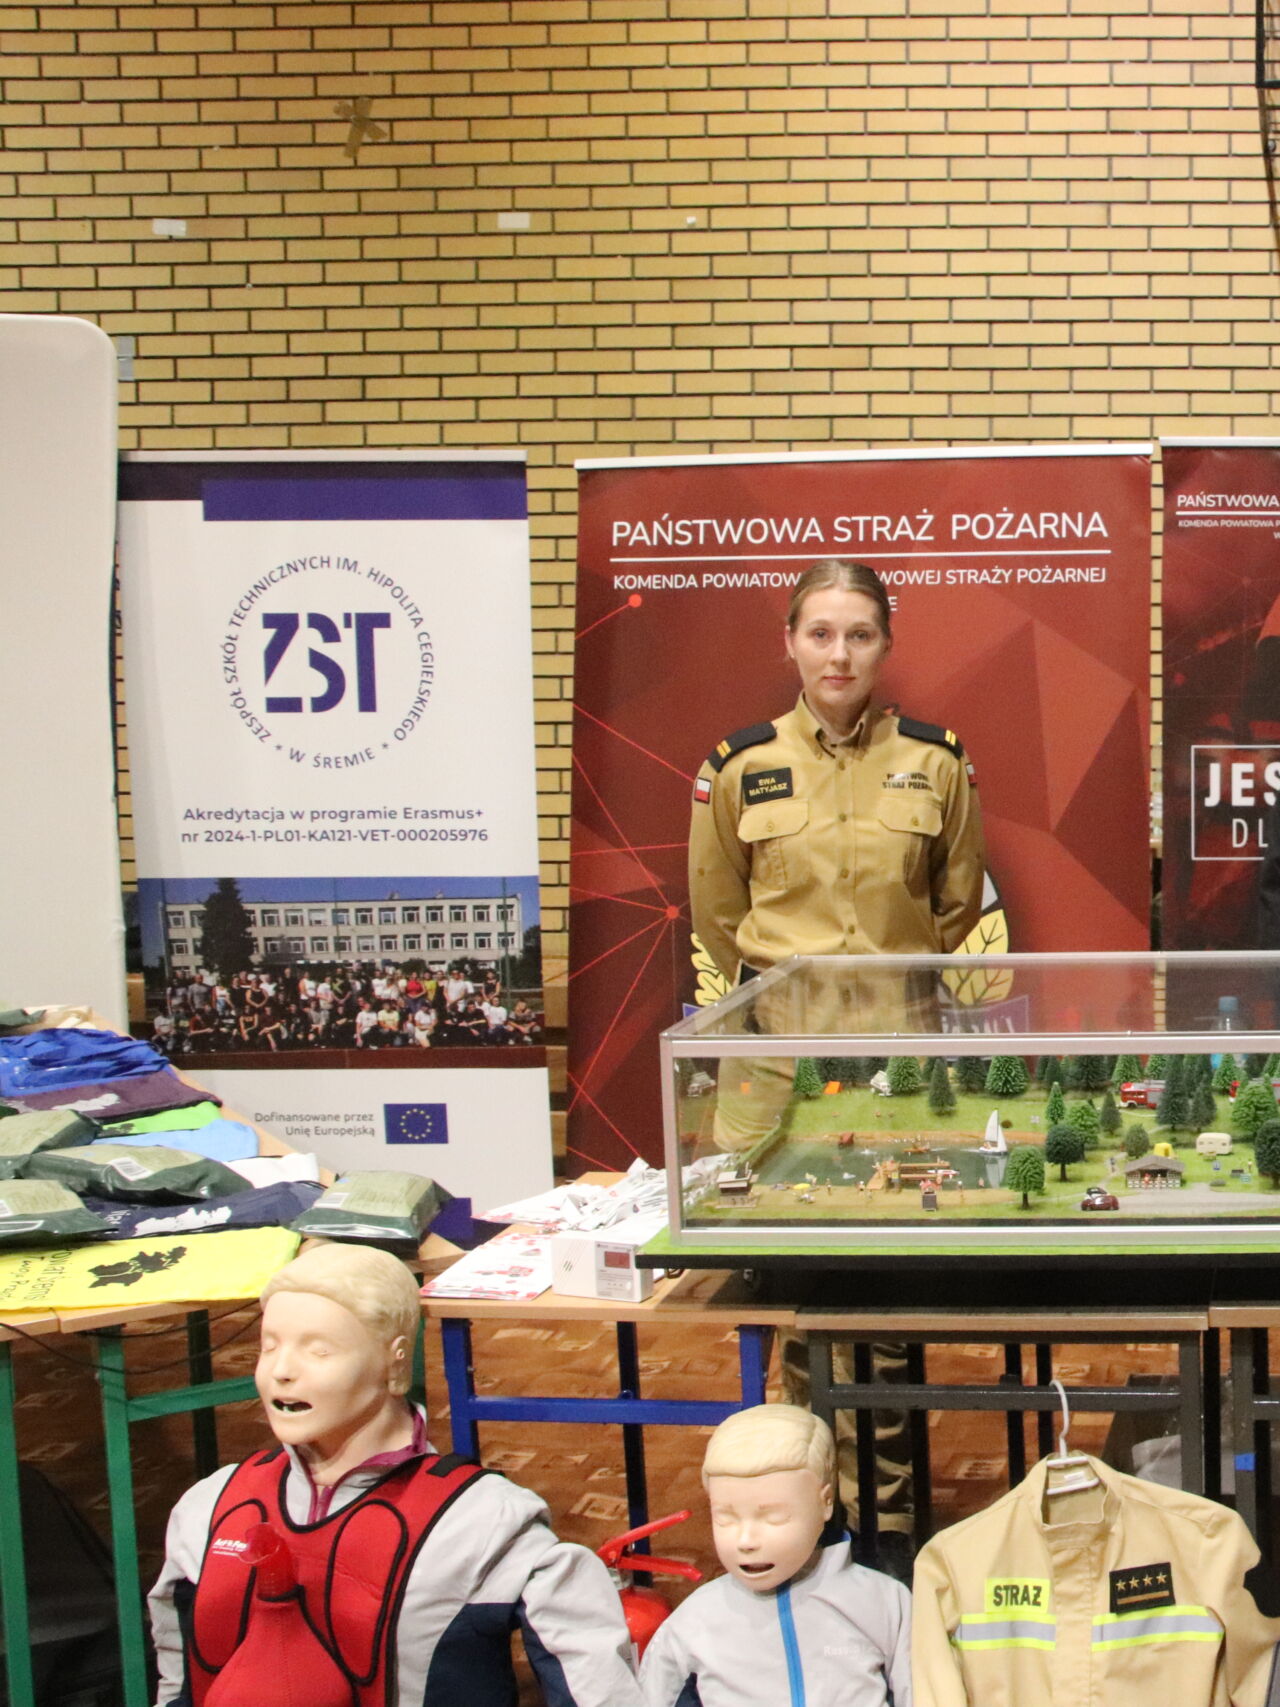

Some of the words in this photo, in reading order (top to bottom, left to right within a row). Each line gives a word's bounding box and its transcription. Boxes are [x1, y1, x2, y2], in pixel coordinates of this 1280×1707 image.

[1177, 491, 1280, 508] PAŃSTWOWA
[612, 513, 825, 546] PAŃSTWOWA
[833, 508, 934, 543] STRAŻ
[952, 507, 1109, 540] POŻARNA
[1178, 519, 1219, 528] KOMENDA
[1220, 519, 1274, 528] POWIATOWA
[336, 557, 362, 576] IM.
[613, 574, 699, 590] KOMENDA
[702, 572, 801, 588] POWIATOW
[875, 569, 941, 585] WOWEJ
[946, 565, 1012, 585] STRAŻY
[1017, 565, 1106, 584] POŻARNEJ
[228, 556, 331, 628] TECHNICZNYCH
[367, 567, 424, 629] HIPOLITA
[220, 633, 239, 685] SZKÓŁ
[262, 612, 391, 713] ZST
[393, 631, 435, 742] CEGIELSKIEGO
[229, 687, 272, 743] ZESPÓŁ
[312, 747, 376, 769] ŚREMIE
[183, 808, 285, 823] Akredytacja
[291, 811, 305, 820] w
[310, 807, 398, 823] programie
[403, 807, 484, 820] Erasmus+
[181, 832, 198, 843] nr
[204, 829, 489, 843] 2024-1-PL01-KA121-VET-000205976
[254, 1111, 341, 1122] Dofinansowane
[344, 1113, 375, 1125] przez
[285, 1126, 310, 1137] Unię
[314, 1126, 375, 1137] Europejską
